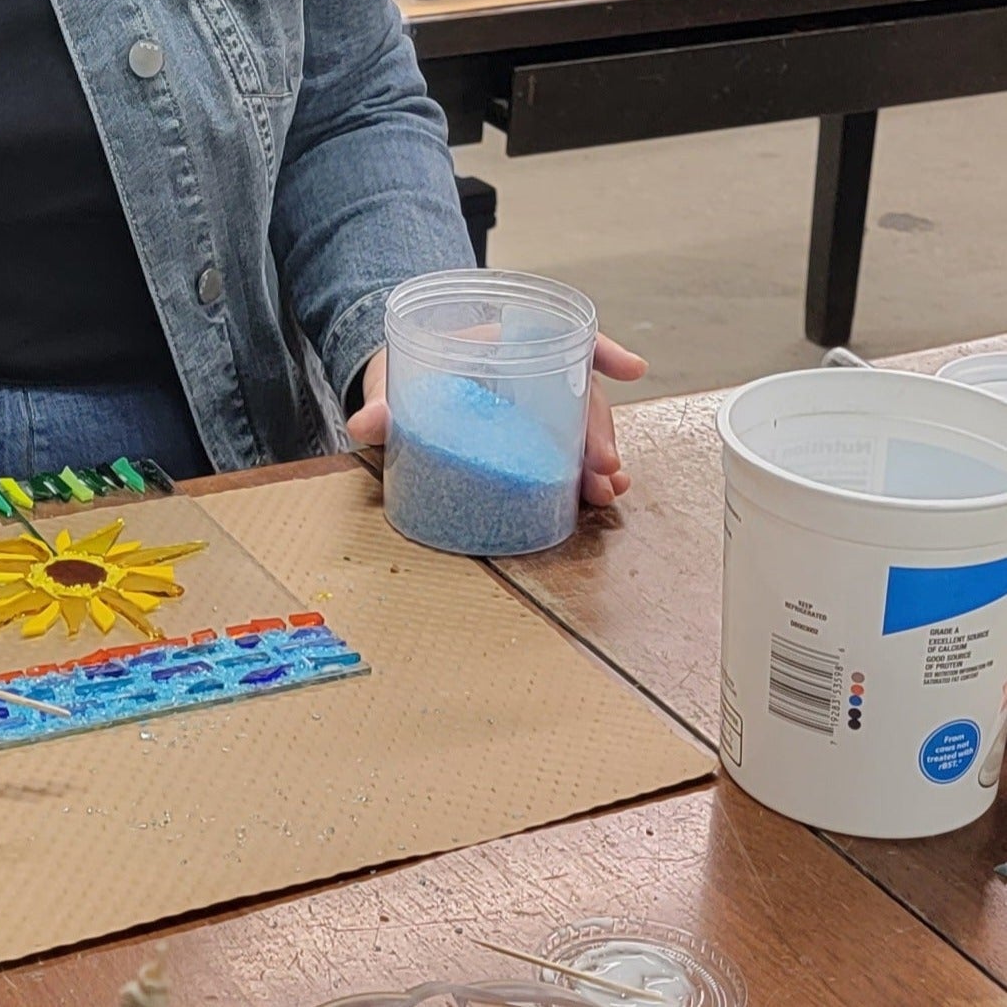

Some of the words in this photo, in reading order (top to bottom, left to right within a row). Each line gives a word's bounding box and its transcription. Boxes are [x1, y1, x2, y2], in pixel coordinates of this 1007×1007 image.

[929, 627, 953, 636] GRADE
[954, 626, 960, 634] A
[928, 635, 966, 645] EXCELLENT
[967, 629, 990, 641] SOURCE
[938, 643, 967, 653] CALCIUM
[926, 655, 946, 663] GOOD
[947, 651, 972, 660] SOURCE
[924, 663, 934, 671] OF
[935, 661, 964, 670] PROTEIN
[943, 733, 965, 744] From
[935, 744, 956, 754] cows
[956, 740, 970, 750] not
[926, 751, 957, 763] treated
[957, 747, 974, 758] with
